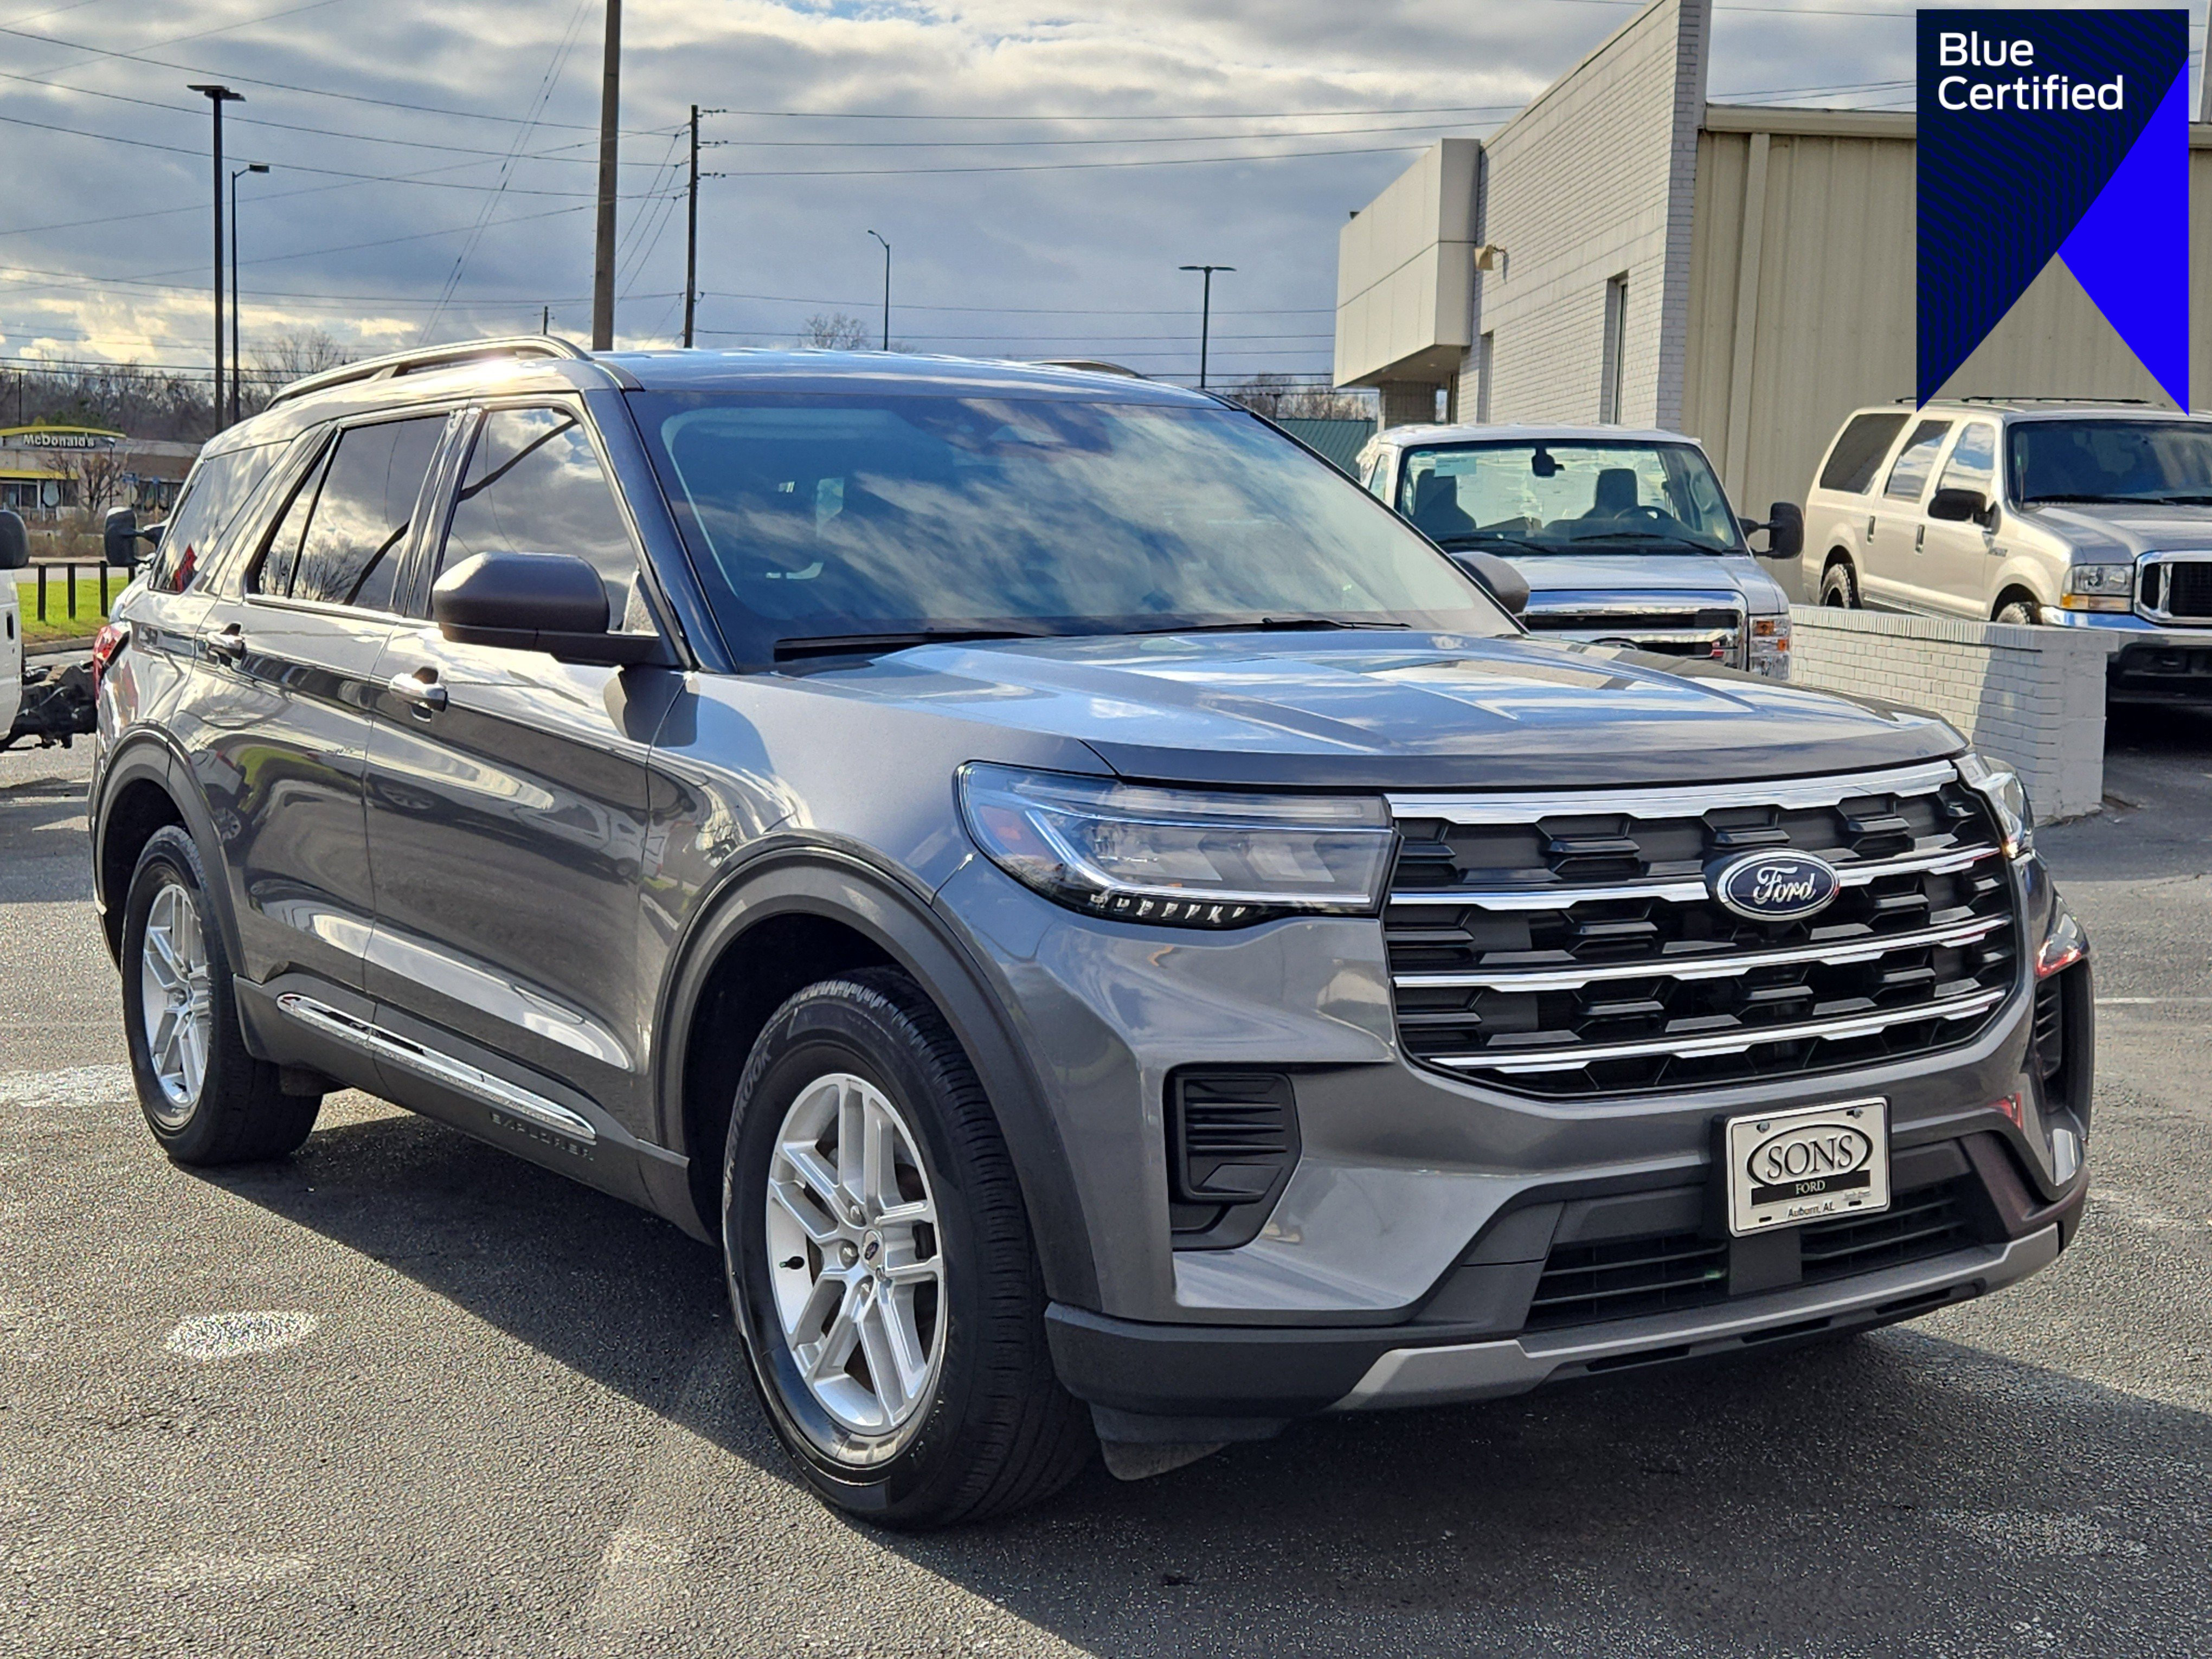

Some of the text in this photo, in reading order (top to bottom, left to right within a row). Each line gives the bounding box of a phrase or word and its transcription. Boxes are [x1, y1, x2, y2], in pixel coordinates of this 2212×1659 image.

[23, 432, 94, 447] McDonald's
[1753, 866, 1817, 905] Ford
[1766, 1134, 1853, 1179] SONS
[1796, 1180, 1826, 1195] FORD
[1823, 1201, 1836, 1213] AL
